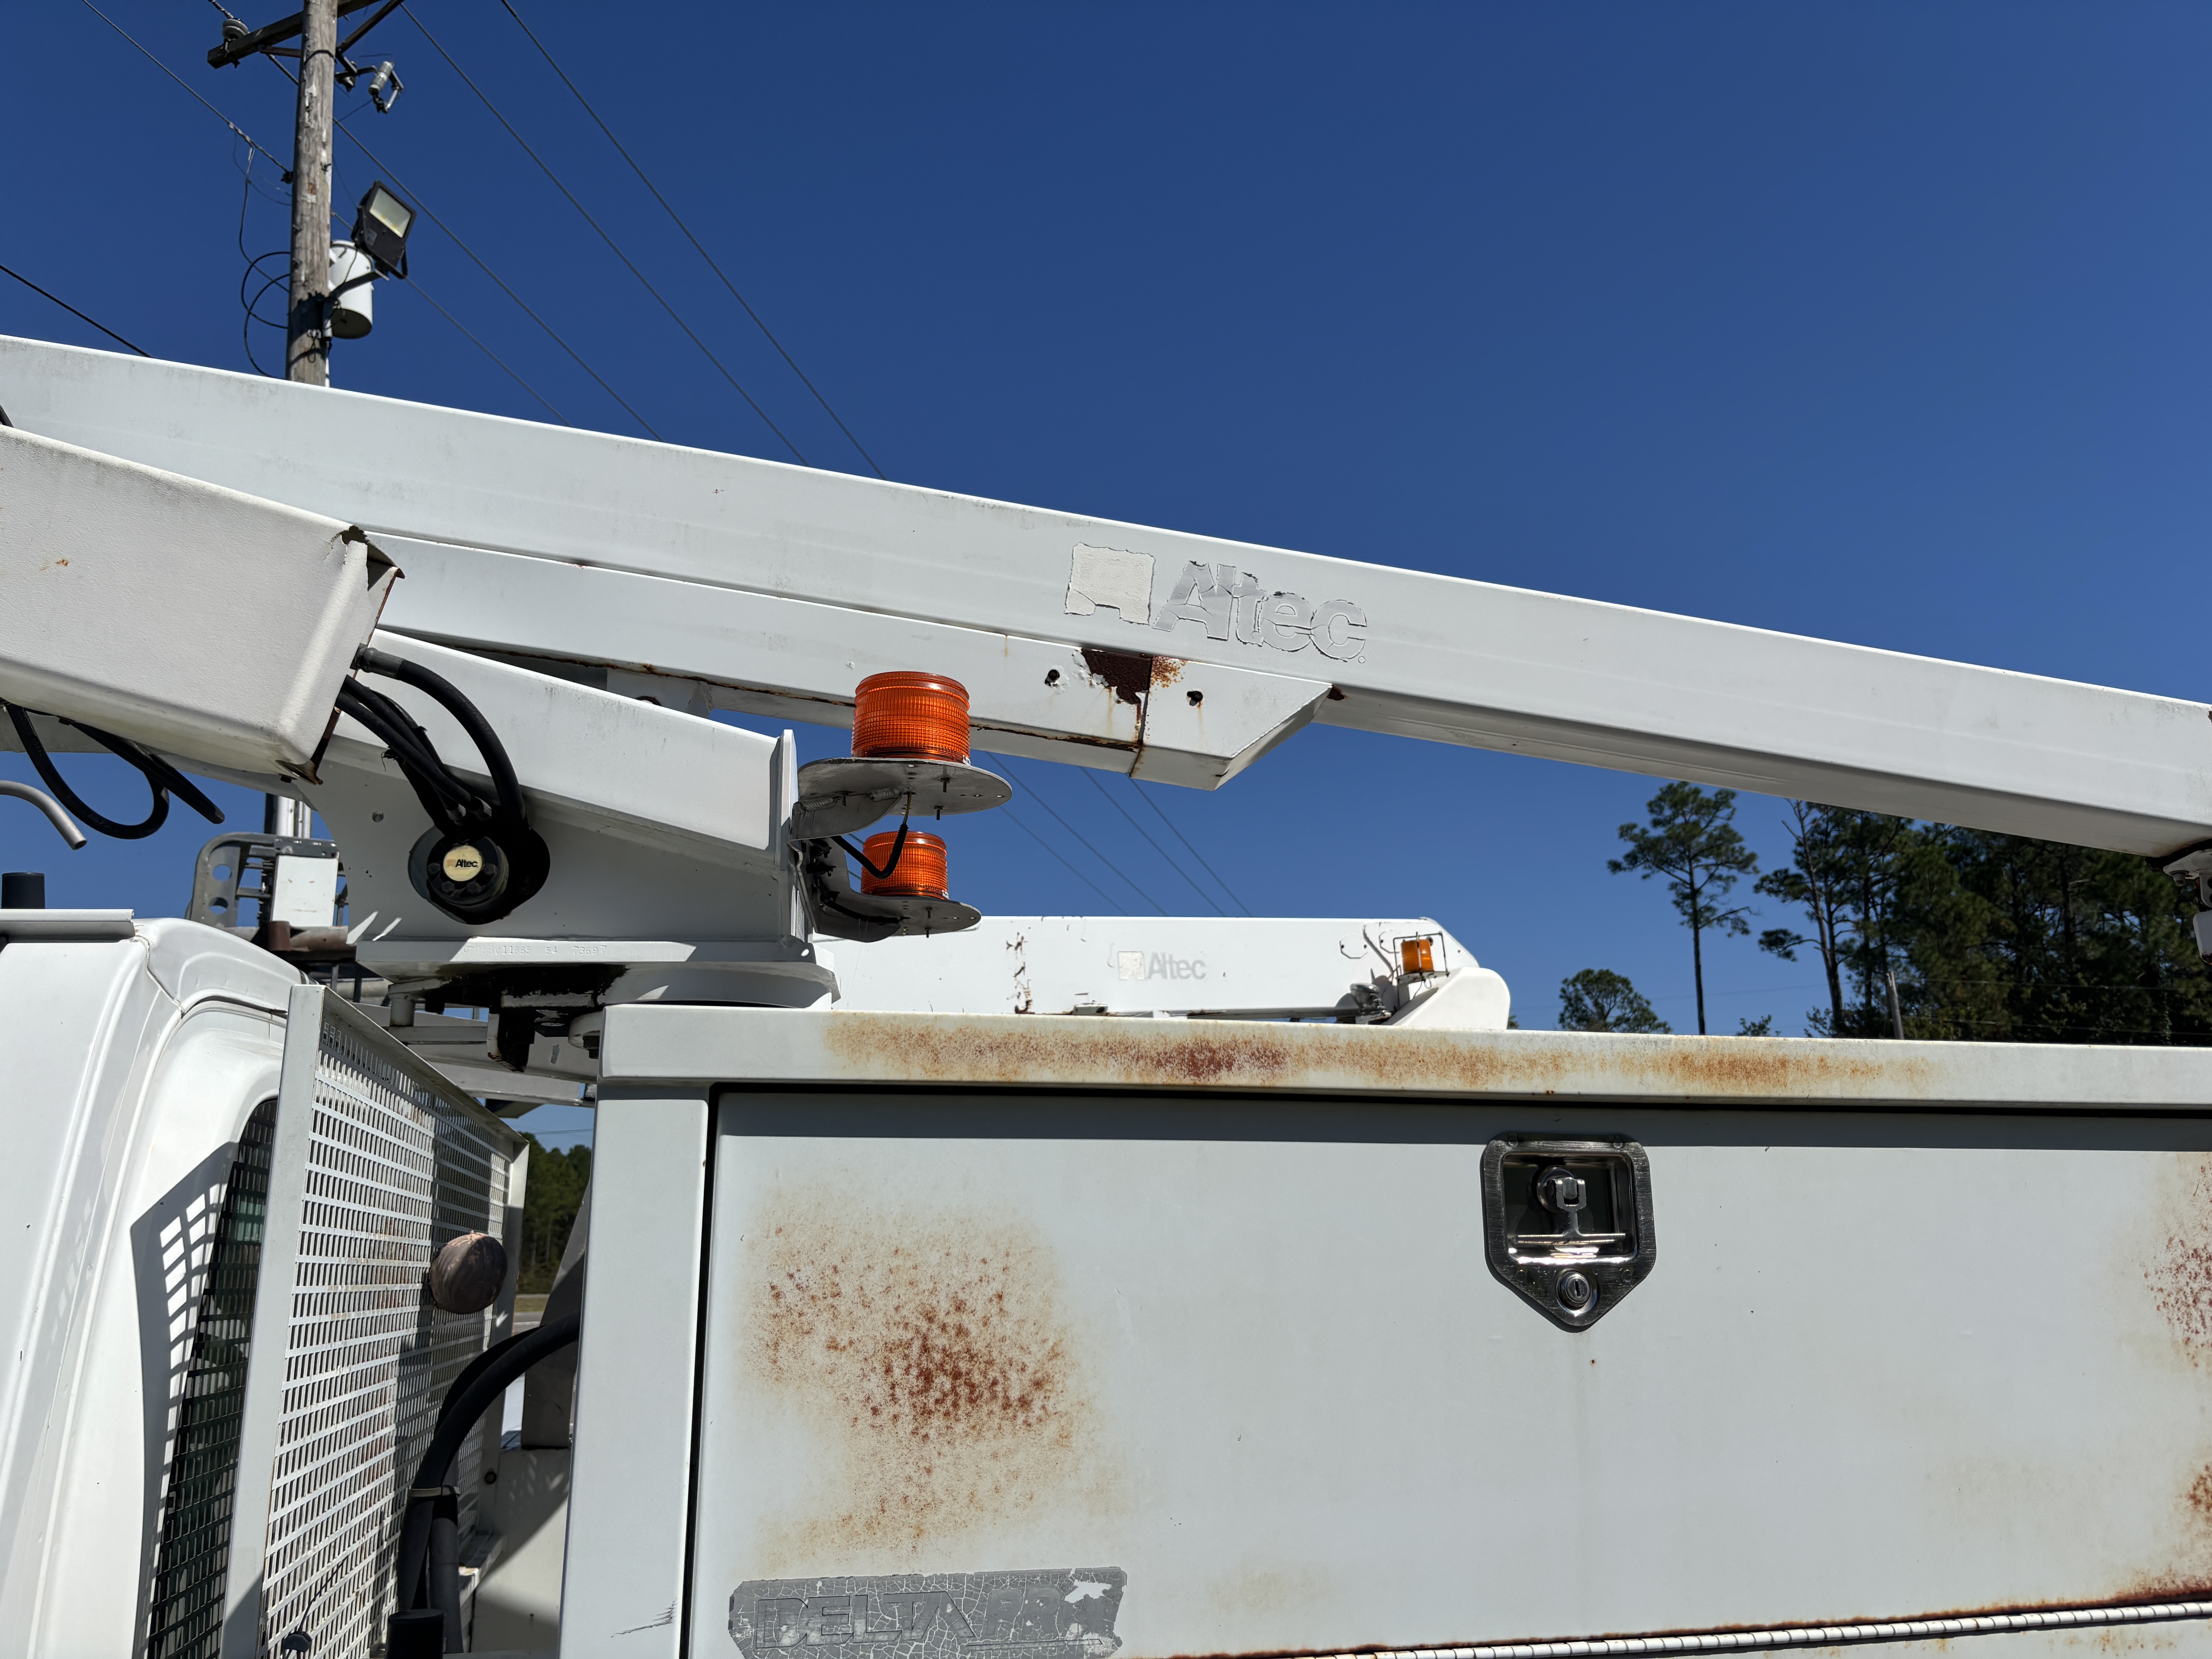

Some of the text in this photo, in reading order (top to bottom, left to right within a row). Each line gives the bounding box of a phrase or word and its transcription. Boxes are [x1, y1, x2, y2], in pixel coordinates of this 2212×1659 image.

[1151, 560, 1367, 663] Altec
[1147, 951, 1206, 979] Altec
[755, 1590, 975, 1649] DELTA
